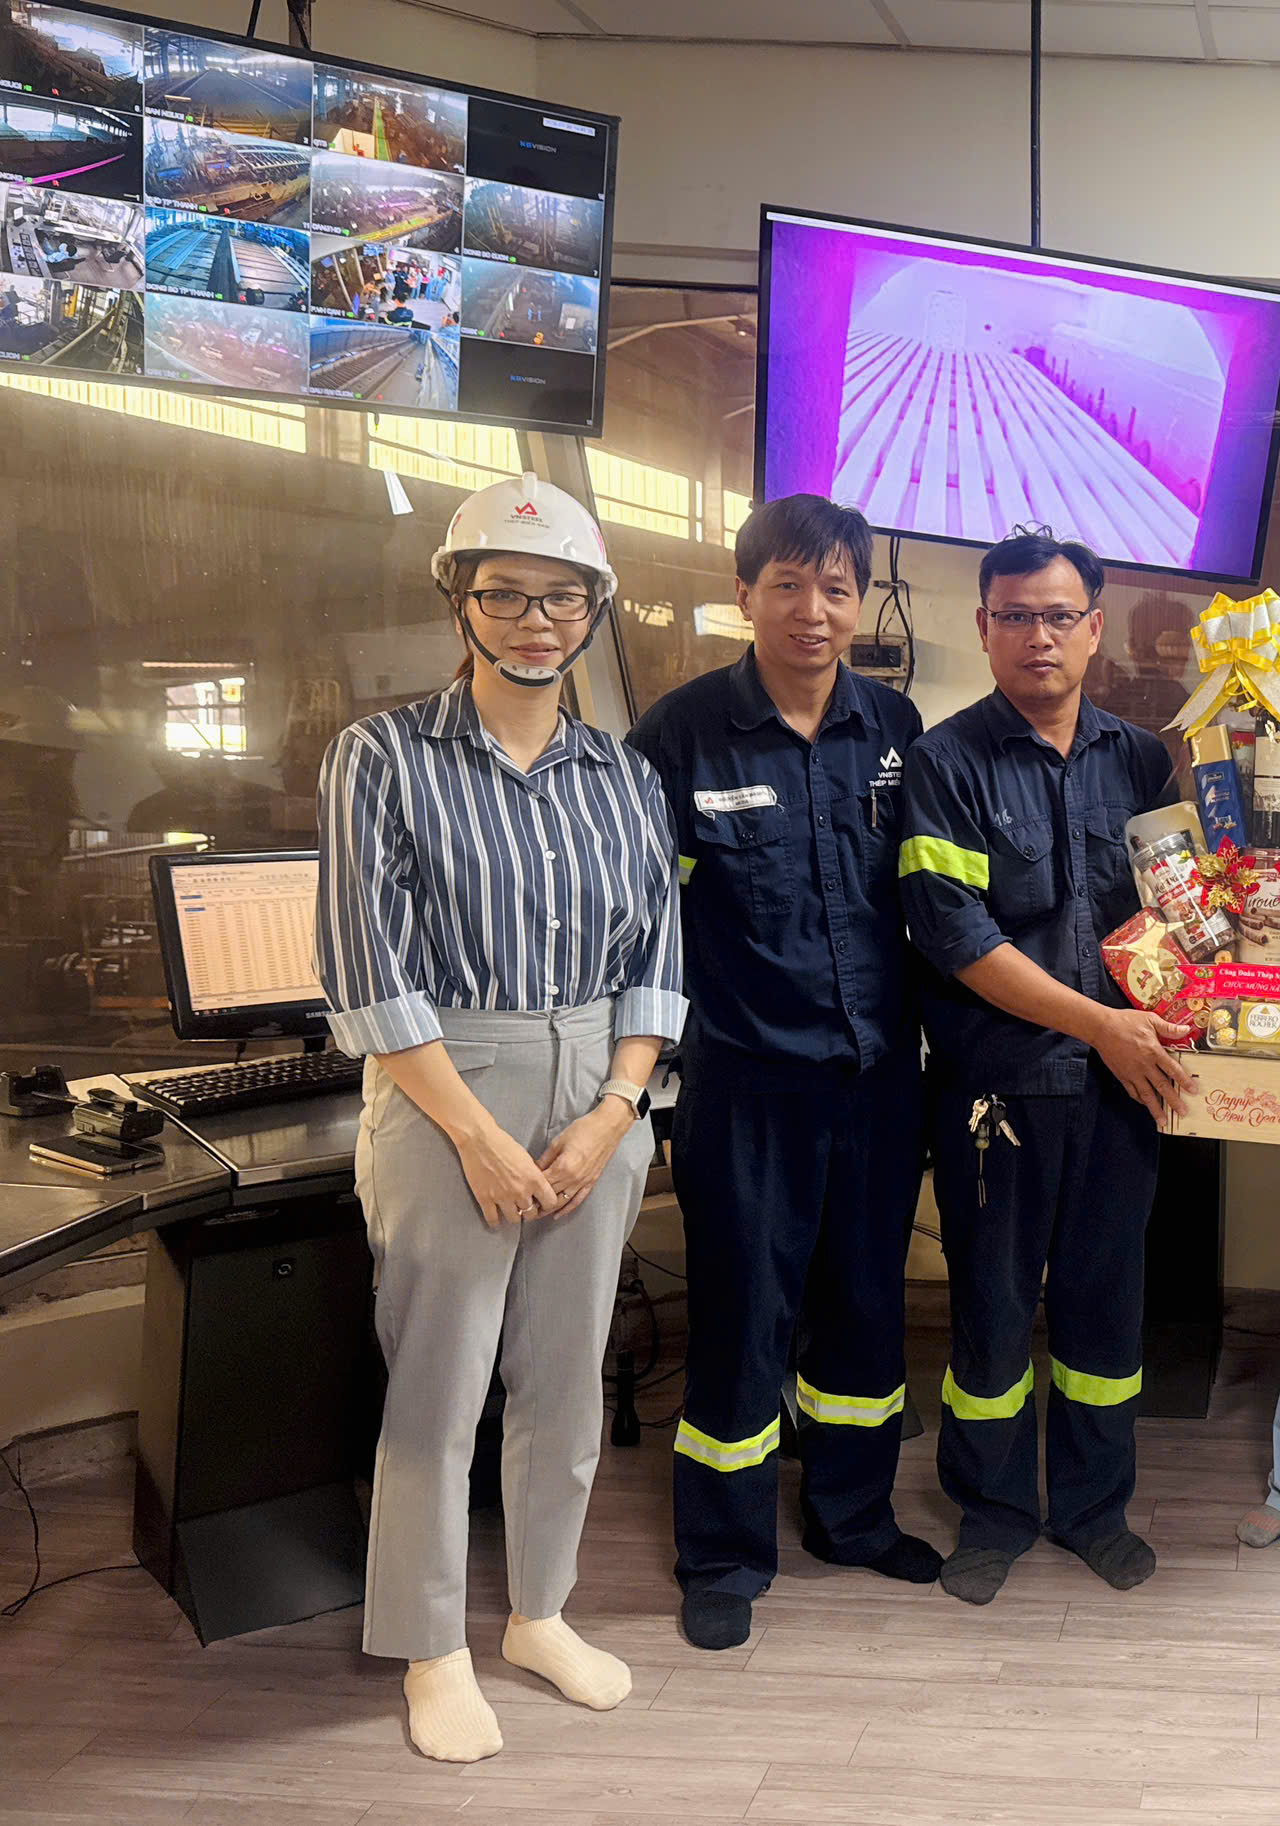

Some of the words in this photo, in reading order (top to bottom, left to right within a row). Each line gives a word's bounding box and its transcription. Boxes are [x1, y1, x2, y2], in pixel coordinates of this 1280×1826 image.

[1250, 1013, 1279, 1022] FERRERO
[1250, 1020, 1278, 1029] ROCHER
[1205, 1089, 1252, 1110] Happy
[1212, 1107, 1246, 1122] New
